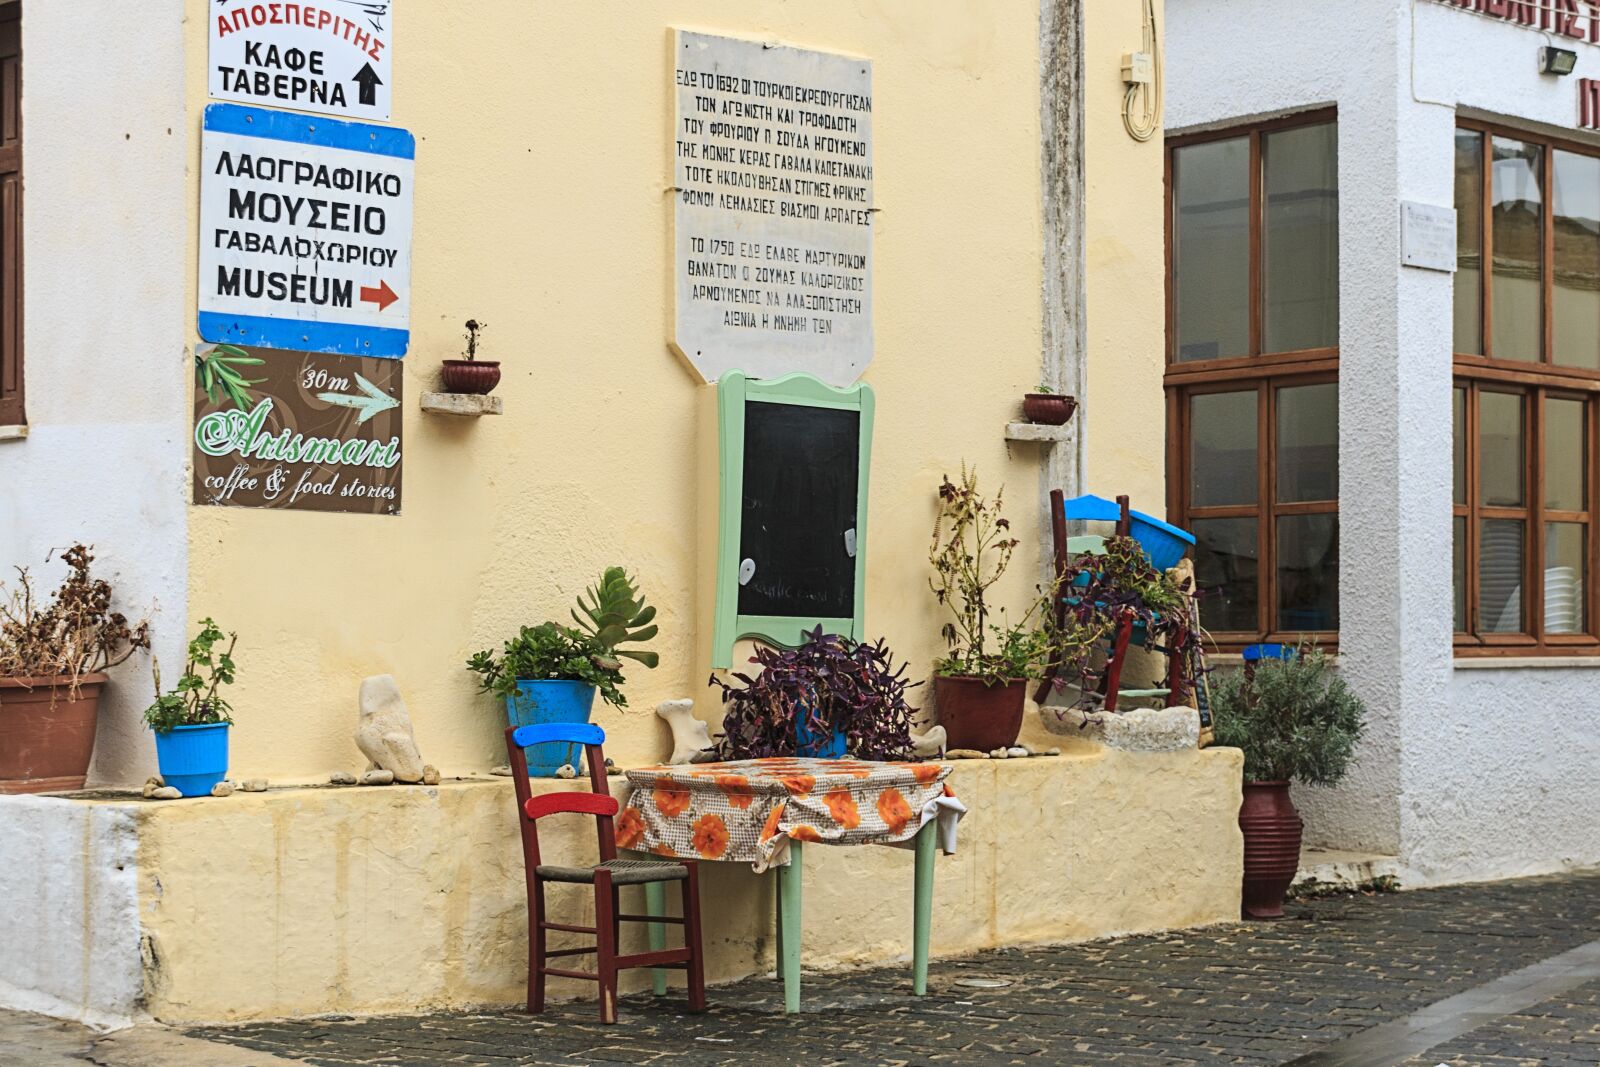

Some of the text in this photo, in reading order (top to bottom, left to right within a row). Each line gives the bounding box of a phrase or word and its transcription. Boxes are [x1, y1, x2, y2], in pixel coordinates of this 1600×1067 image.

[217, 3, 385, 62] ΑΠΟΣΠΕΡΙΤΗΣ
[244, 40, 324, 75] ΚΑΦΕ
[218, 65, 347, 107] ΤΑΒΕΡΝΑ
[676, 69, 697, 87] ΕΔΩ
[700, 73, 713, 89] ΤΟ
[716, 74, 739, 93] 1692
[741, 79, 751, 95] ΟΙ
[753, 80, 794, 102] ΤΟΥΡΚΟΙ
[696, 96, 857, 133] ΤΟΝ ΑΓΩΝΙΣΤΗ ΚΑΙ ΤΡΟΦΟΔΟΤΗ
[684, 118, 704, 135] ΤΟΥ
[710, 121, 760, 142] ΦΡΟΥΡΙΟΥ
[777, 130, 809, 149] ΣΟΥΔΑ
[814, 135, 866, 157] ΗΓΟΥΜΕΝΟ
[215, 150, 401, 198] ΛΑΟΓΡΑΦΙΚΟ
[676, 141, 873, 181] ΤΗΣ ΜΟΝΗΣ ΚΕΡΑΣ ΓΑΒΑΛΑ ΚΑΠΕΤΑΝΑΚΗ
[685, 165, 866, 203] ΤΟΤΕ ΗΚΟΛΟΥΘΗΣΑΝ ΣΤΙΓΜΕΣ ΦΡΙΚΗΣ
[228, 188, 386, 236] ΜΟΥΣΕΙΟ
[682, 188, 871, 226] ΦΟΝΟΙ ΛΕΗΛΑΣΙΕΣ ΒΙΑΣΜΟΙ ΑΡΠΑΓΕΣ
[214, 228, 398, 268] ΓΑΒΑΛΟΧΩΡΙΟΥ
[691, 237, 866, 270] ΤΟ 1750 ΕΔΩ ΕΛΑΒΕ ΜΑΡΤΥΡΙΚΟΝ
[217, 265, 353, 308] MUSEUM
[688, 259, 737, 280] ΘΑΝΑΤΟΝ
[755, 267, 796, 285] ΖΟΥΜΑΣ
[801, 271, 864, 292] ΚΑΛΟΡΙΖΙΚΟΣ
[692, 284, 761, 305] ΑΡΝΟΥΜΕΝΟΣ
[766, 291, 780, 307] ΝΑ
[723, 310, 832, 334] ΑΙΩΝΙΑ Η ΜΝΗΜΗ ΤΩΝ
[195, 397, 400, 468] Arismari
[204, 464, 396, 503] coffee & food stories
